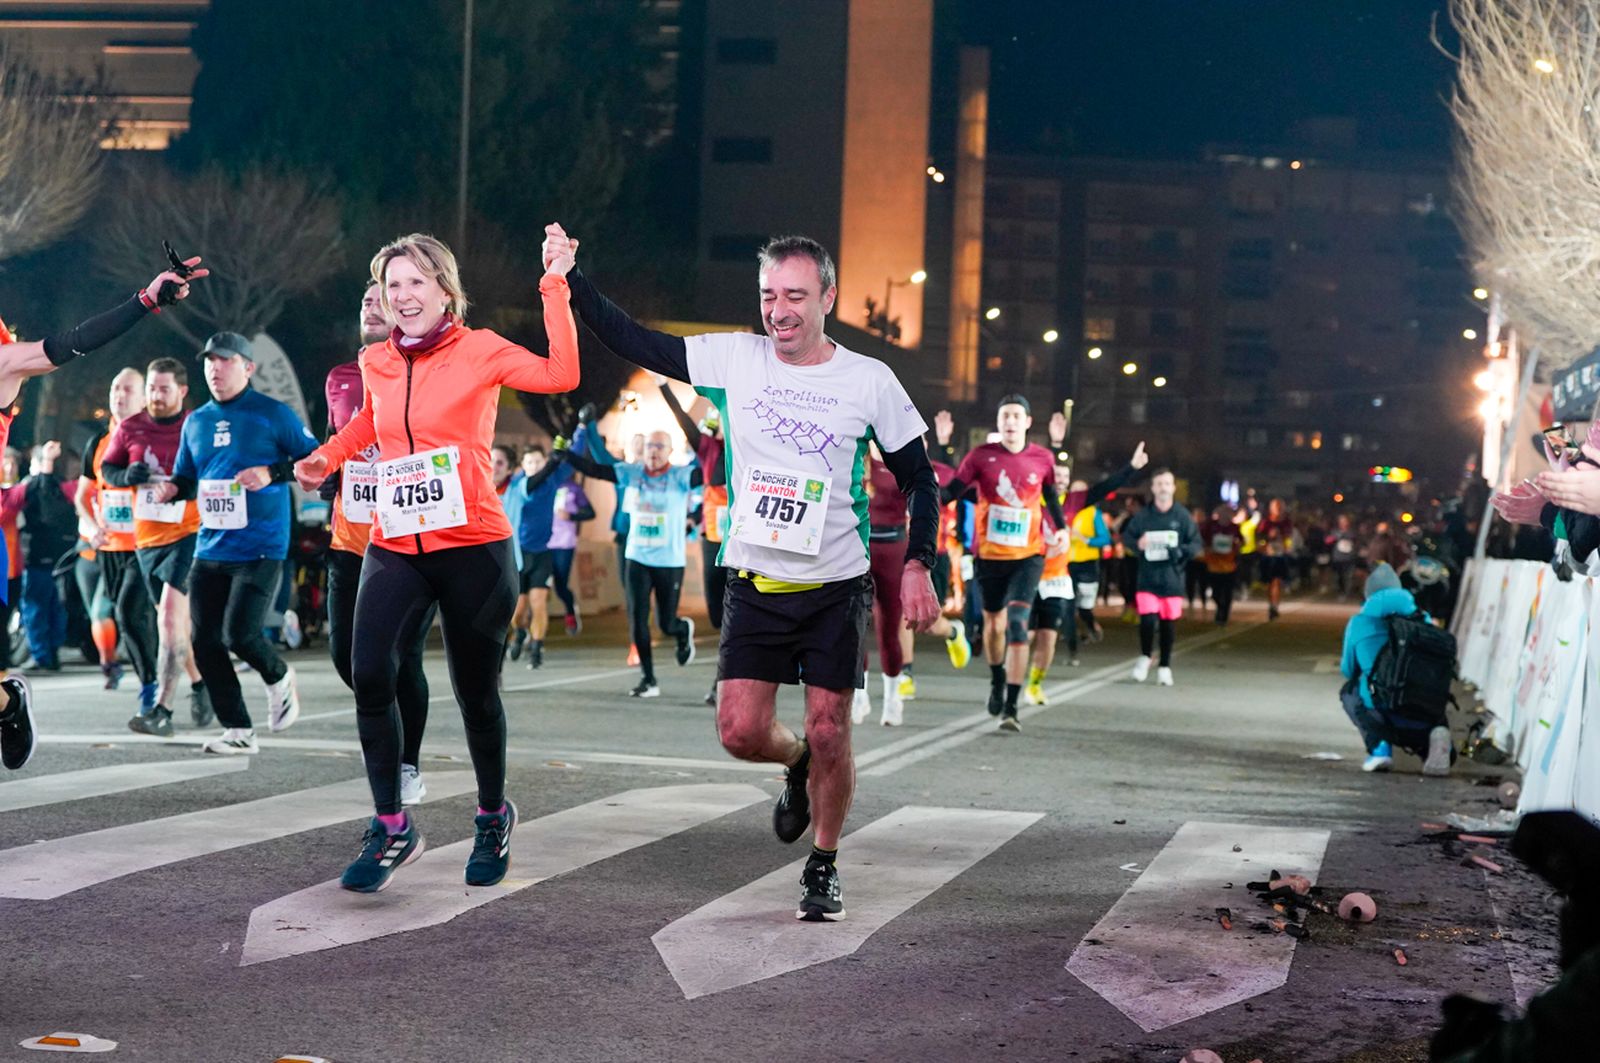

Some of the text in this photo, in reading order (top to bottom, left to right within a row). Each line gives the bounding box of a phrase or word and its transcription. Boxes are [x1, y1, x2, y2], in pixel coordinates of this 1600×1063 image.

[395, 464, 415, 475] NOCHE
[415, 462, 425, 471] DE
[385, 476, 401, 487] SAN
[762, 475, 787, 486] NOCHE
[787, 478, 799, 488] DE
[392, 478, 444, 508] 4759
[750, 483, 767, 492] SAN
[767, 486, 797, 498] ANTÓN
[205, 498, 235, 512] 3075
[755, 495, 809, 525] 4757
[766, 521, 789, 530] Salvador
